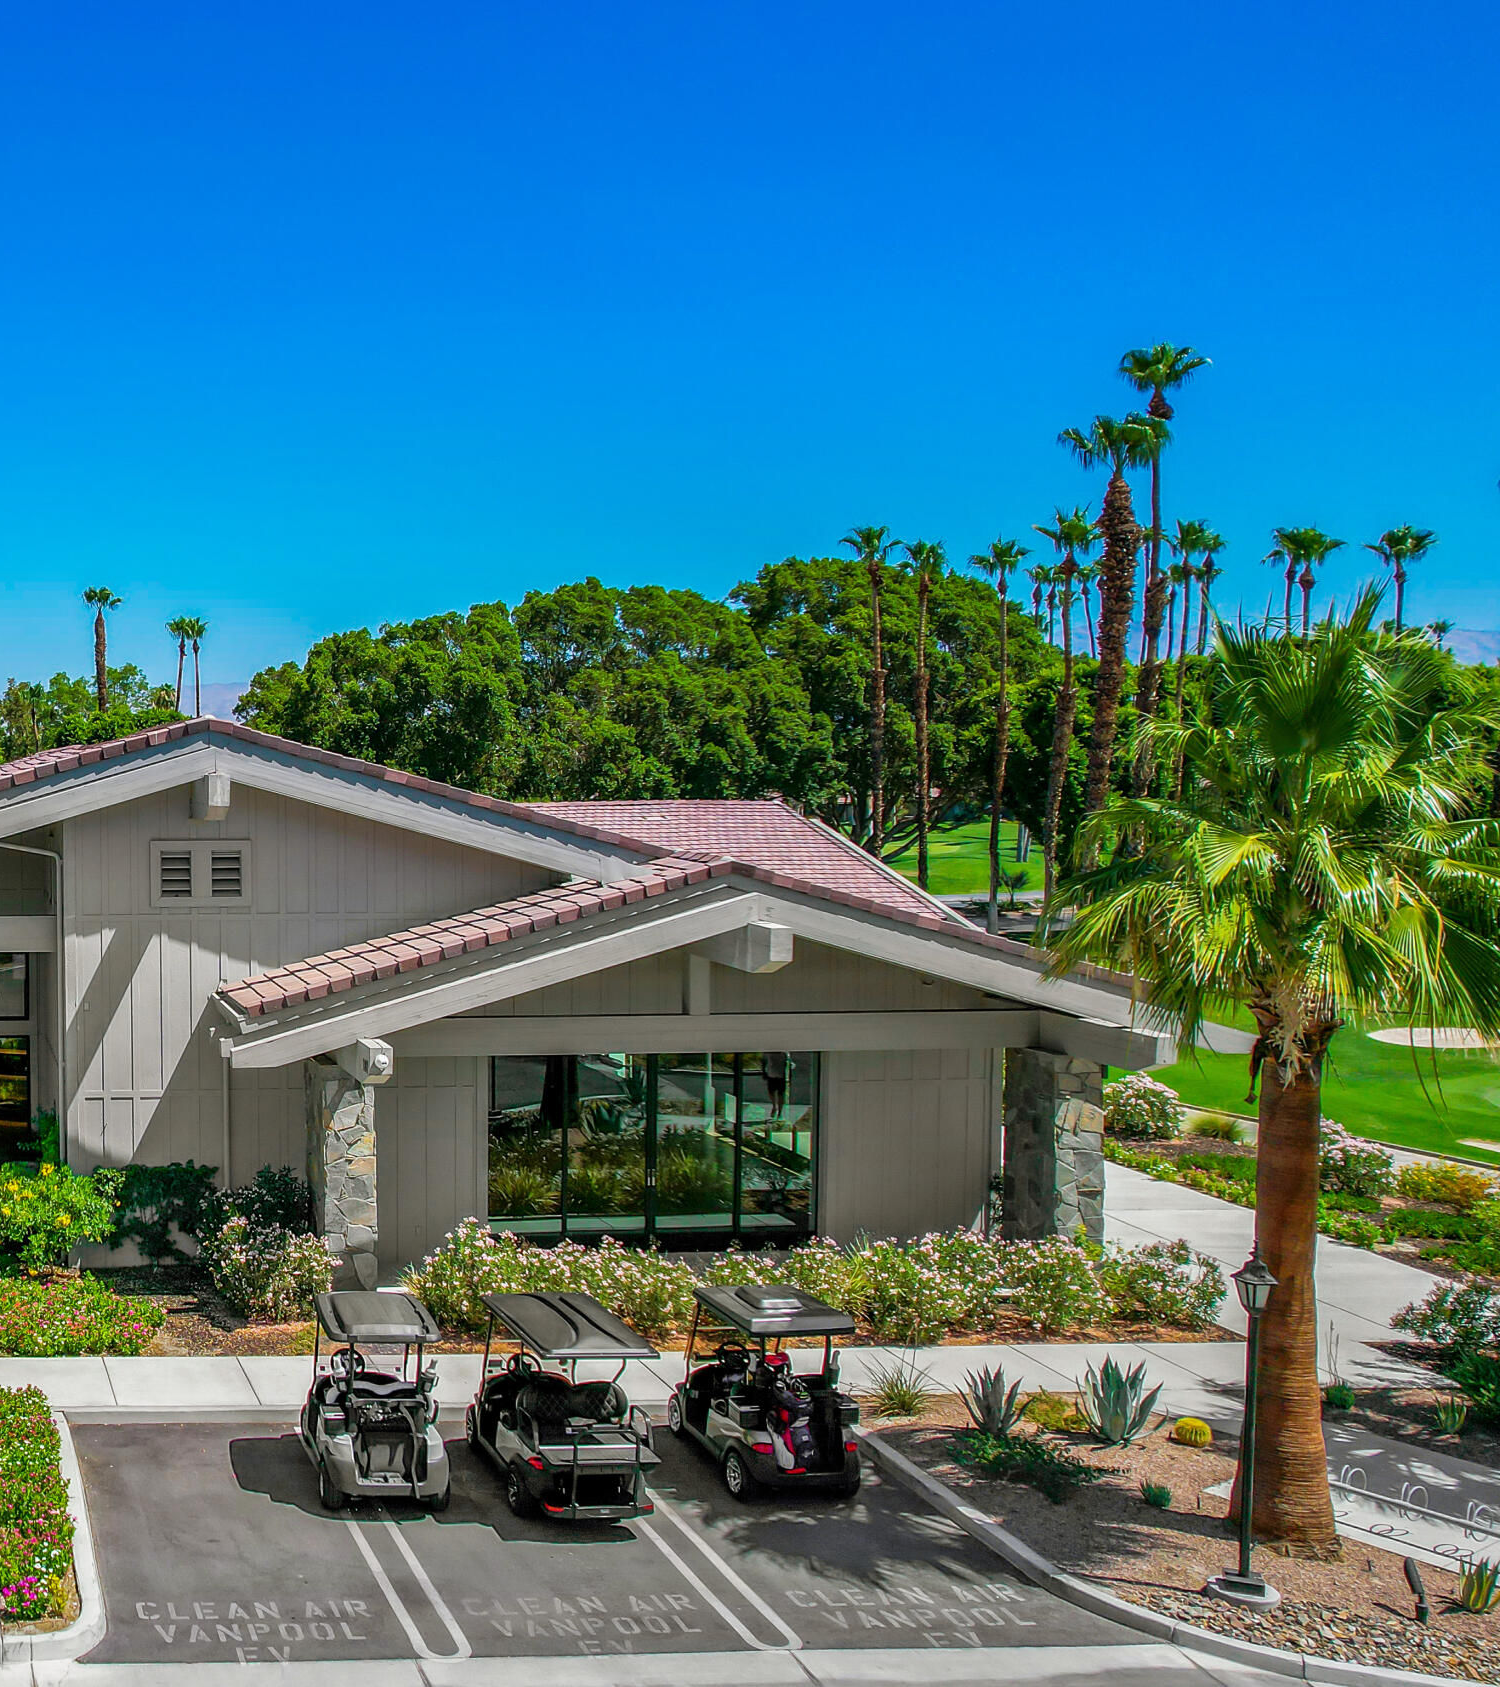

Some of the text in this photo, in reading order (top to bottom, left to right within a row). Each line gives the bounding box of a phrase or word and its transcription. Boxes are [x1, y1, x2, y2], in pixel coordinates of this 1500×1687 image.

[460, 1594, 698, 1616] CLEAN AIR
[784, 1583, 1026, 1608] CLEAN AIR
[135, 1600, 372, 1620] CLEAN AIR
[820, 1607, 1037, 1628] VANPOOL
[154, 1621, 367, 1643] VANPOOL
[490, 1614, 703, 1637] VANPOOL
